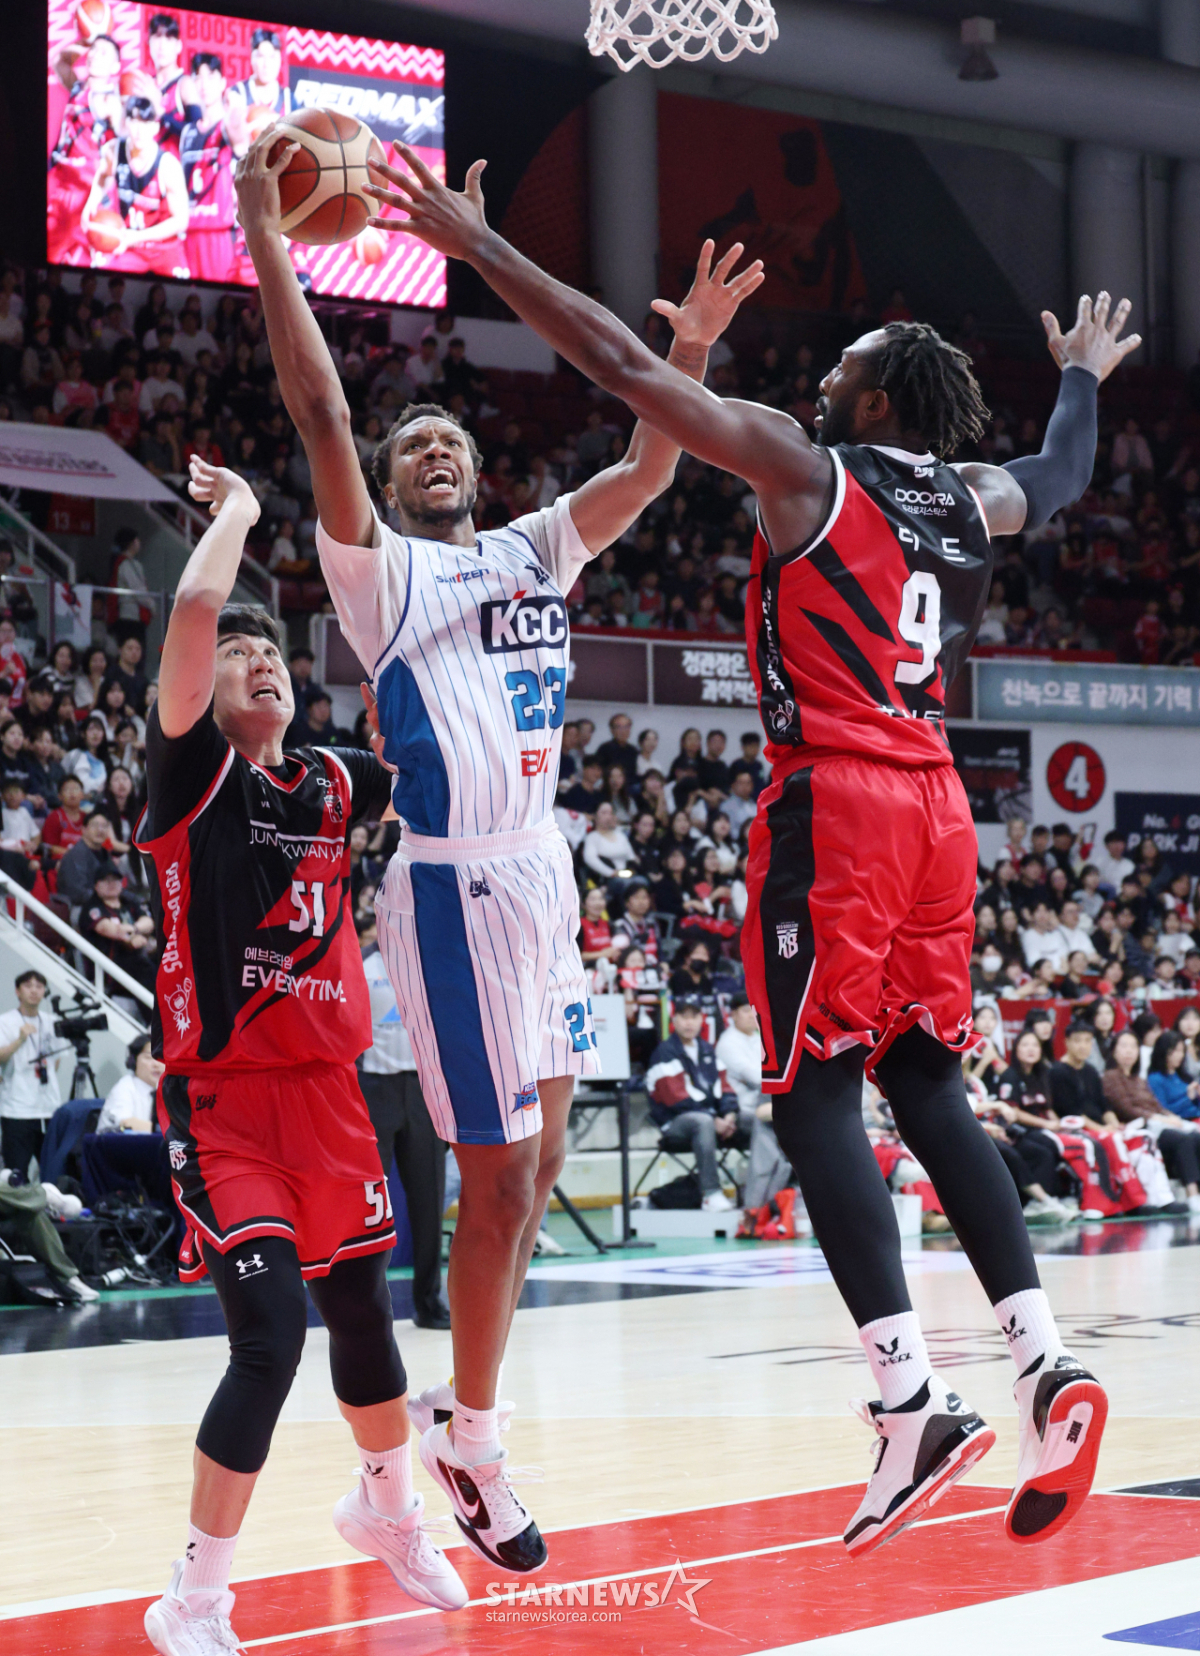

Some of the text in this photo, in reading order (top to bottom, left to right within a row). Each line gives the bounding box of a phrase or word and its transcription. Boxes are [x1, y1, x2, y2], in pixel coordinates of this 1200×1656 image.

[294, 79, 445, 130] REDMAX
[895, 488, 956, 506] DOORA
[491, 590, 566, 648] KCC
[894, 570, 942, 684] 9
[504, 666, 566, 732] 23
[1064, 754, 1090, 800] 4
[249, 828, 281, 847] JUN
[1126, 832, 1178, 852] PRK
[288, 880, 325, 937] 51
[363, 1174, 394, 1228] 51
